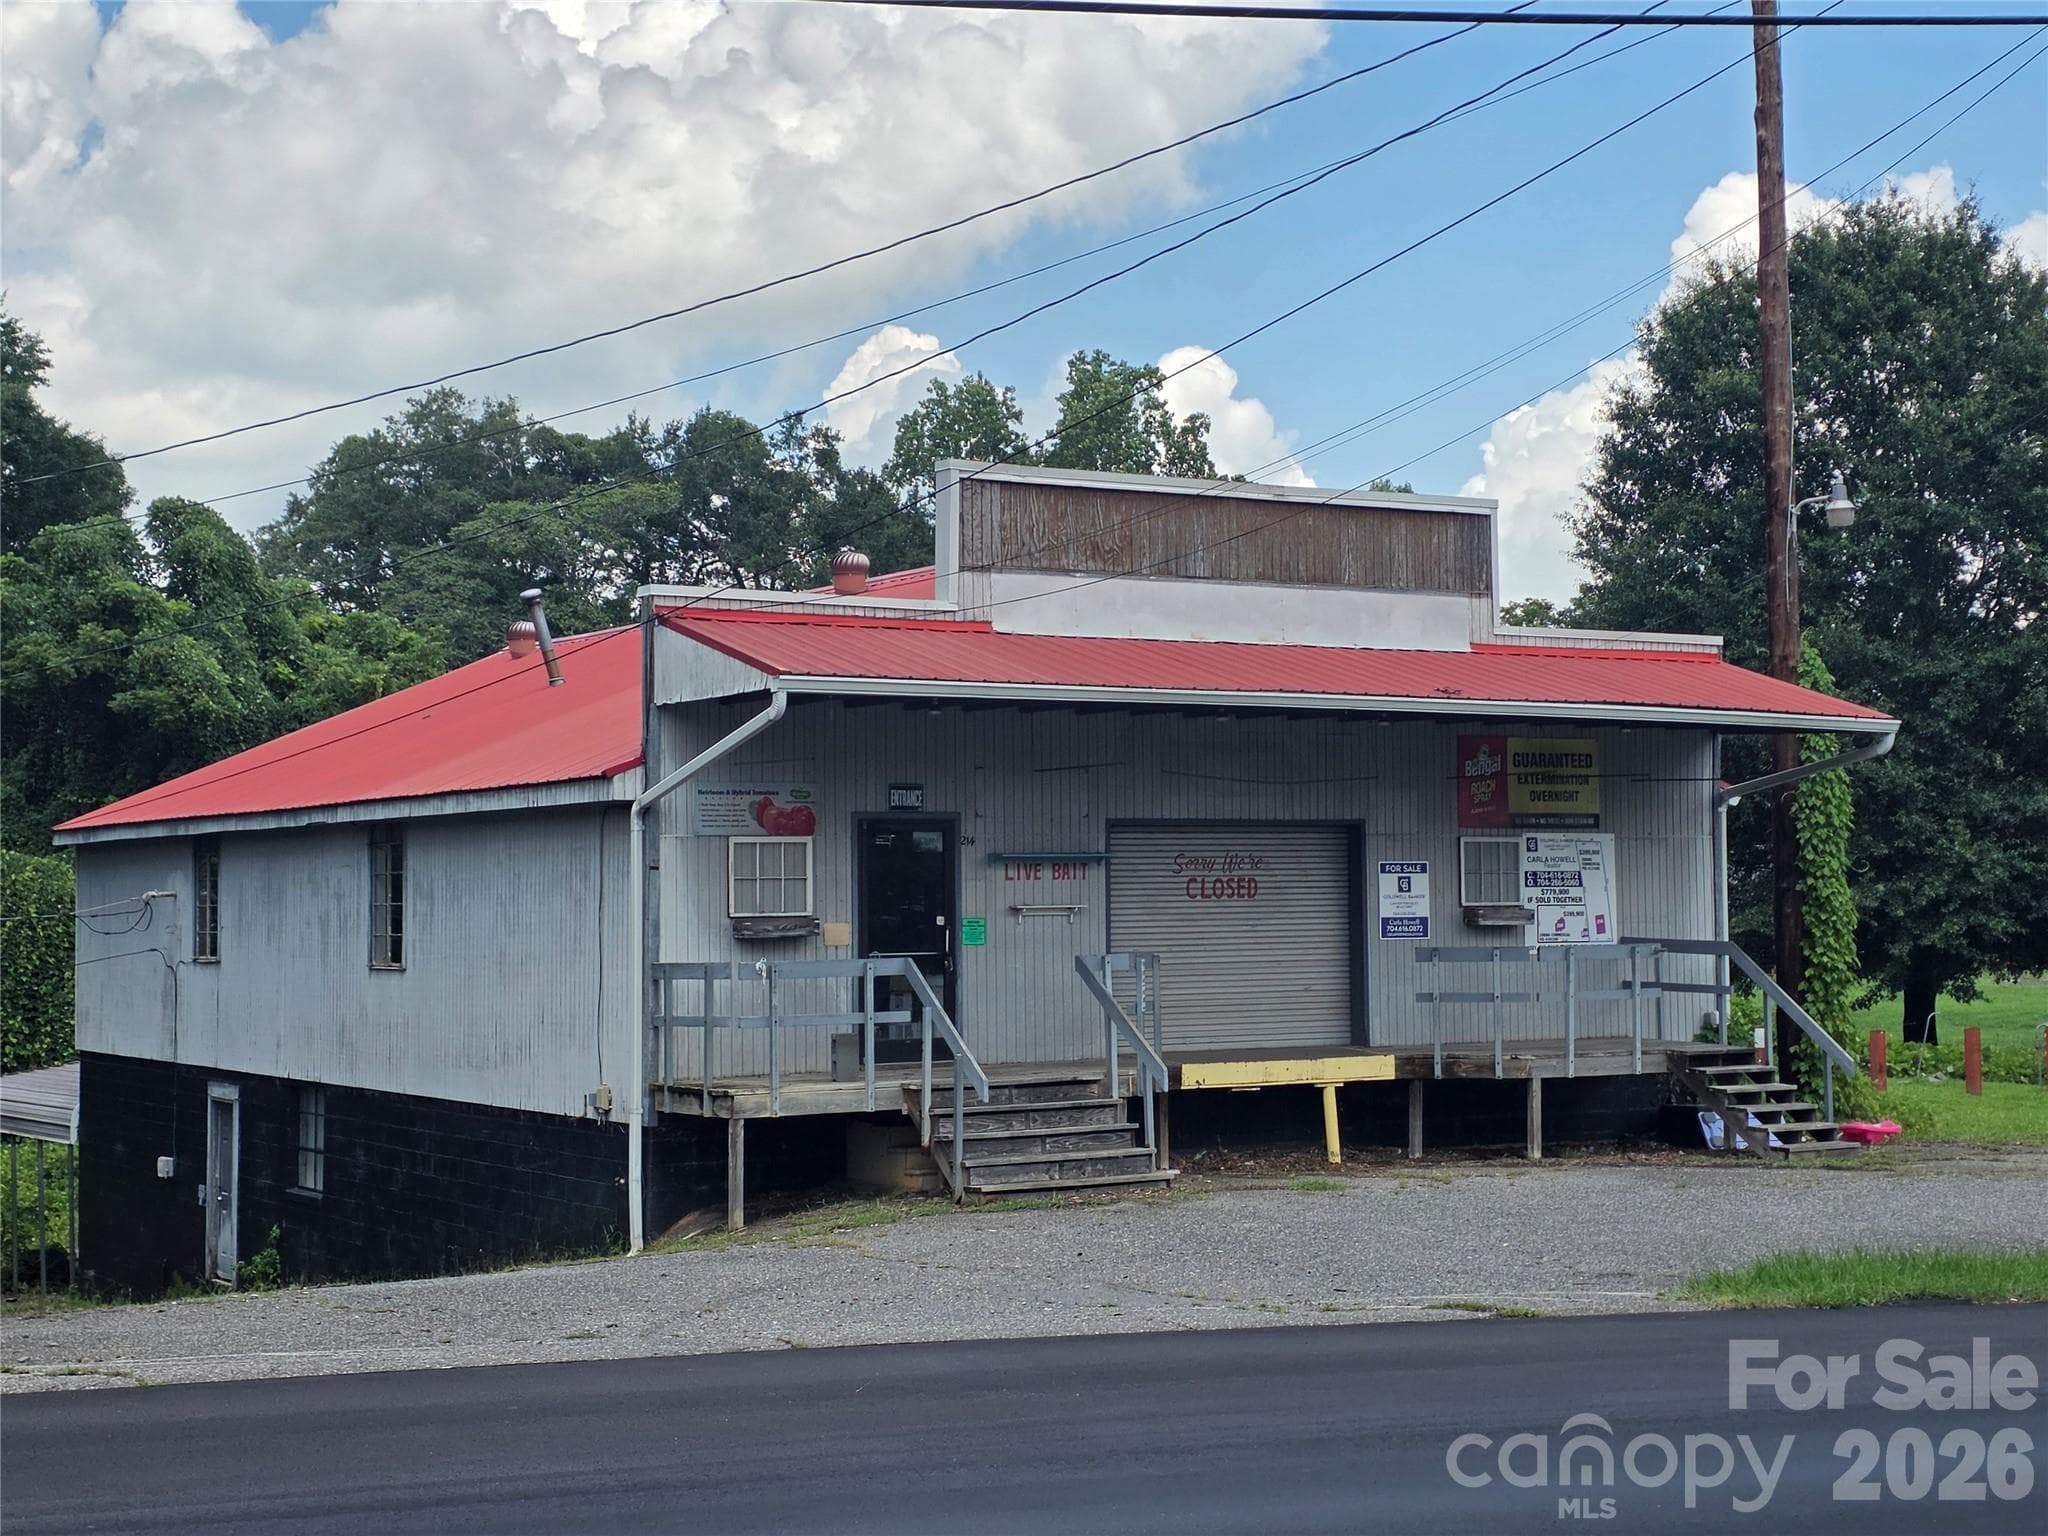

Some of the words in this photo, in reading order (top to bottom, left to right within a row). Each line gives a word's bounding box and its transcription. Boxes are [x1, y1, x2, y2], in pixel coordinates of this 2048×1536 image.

[1465, 754, 1501, 776] Bengal
[1513, 752, 1593, 768] GUARANTEED
[1517, 774, 1589, 785] EXTERMINATION
[890, 789, 922, 806] ENTRANCE
[1529, 790, 1579, 802] OVERNIGHT
[1005, 863, 1041, 881] LIVE
[1052, 862, 1088, 881] BAIT
[1172, 853, 1216, 874] Sorry
[1385, 864, 1401, 872] FOR
[1403, 864, 1422, 872] SALE
[1186, 877, 1258, 899] CLOSED
